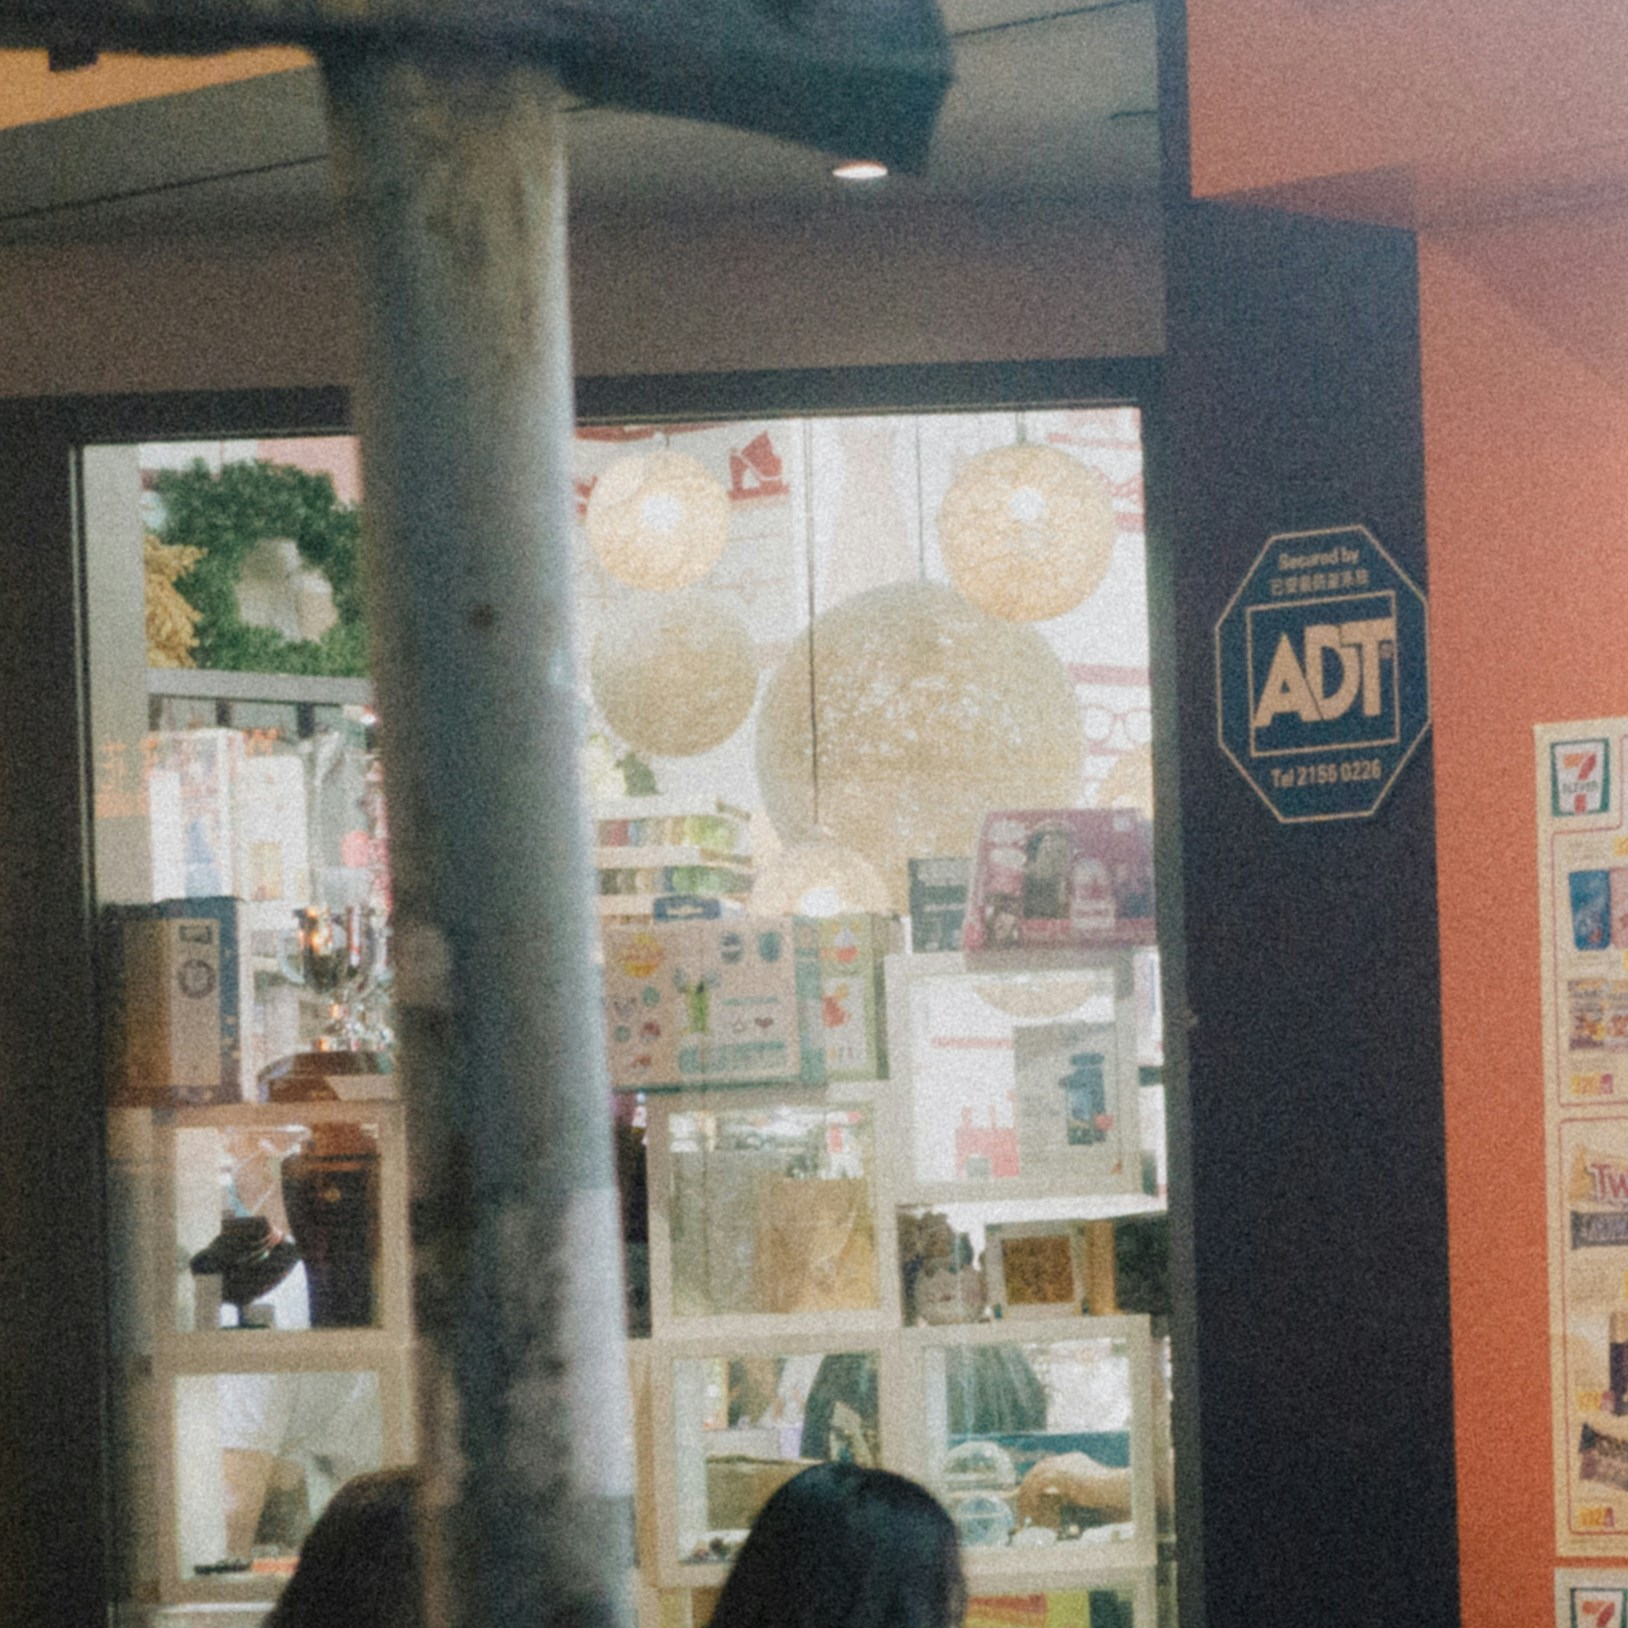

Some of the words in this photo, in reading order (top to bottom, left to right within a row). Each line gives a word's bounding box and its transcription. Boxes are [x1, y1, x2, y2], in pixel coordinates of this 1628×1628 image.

[1341, 546, 1360, 566] by
[1253, 617, 1396, 728] ADT
[1271, 767, 1294, 788] Tel
[1340, 758, 1382, 782] 0226
